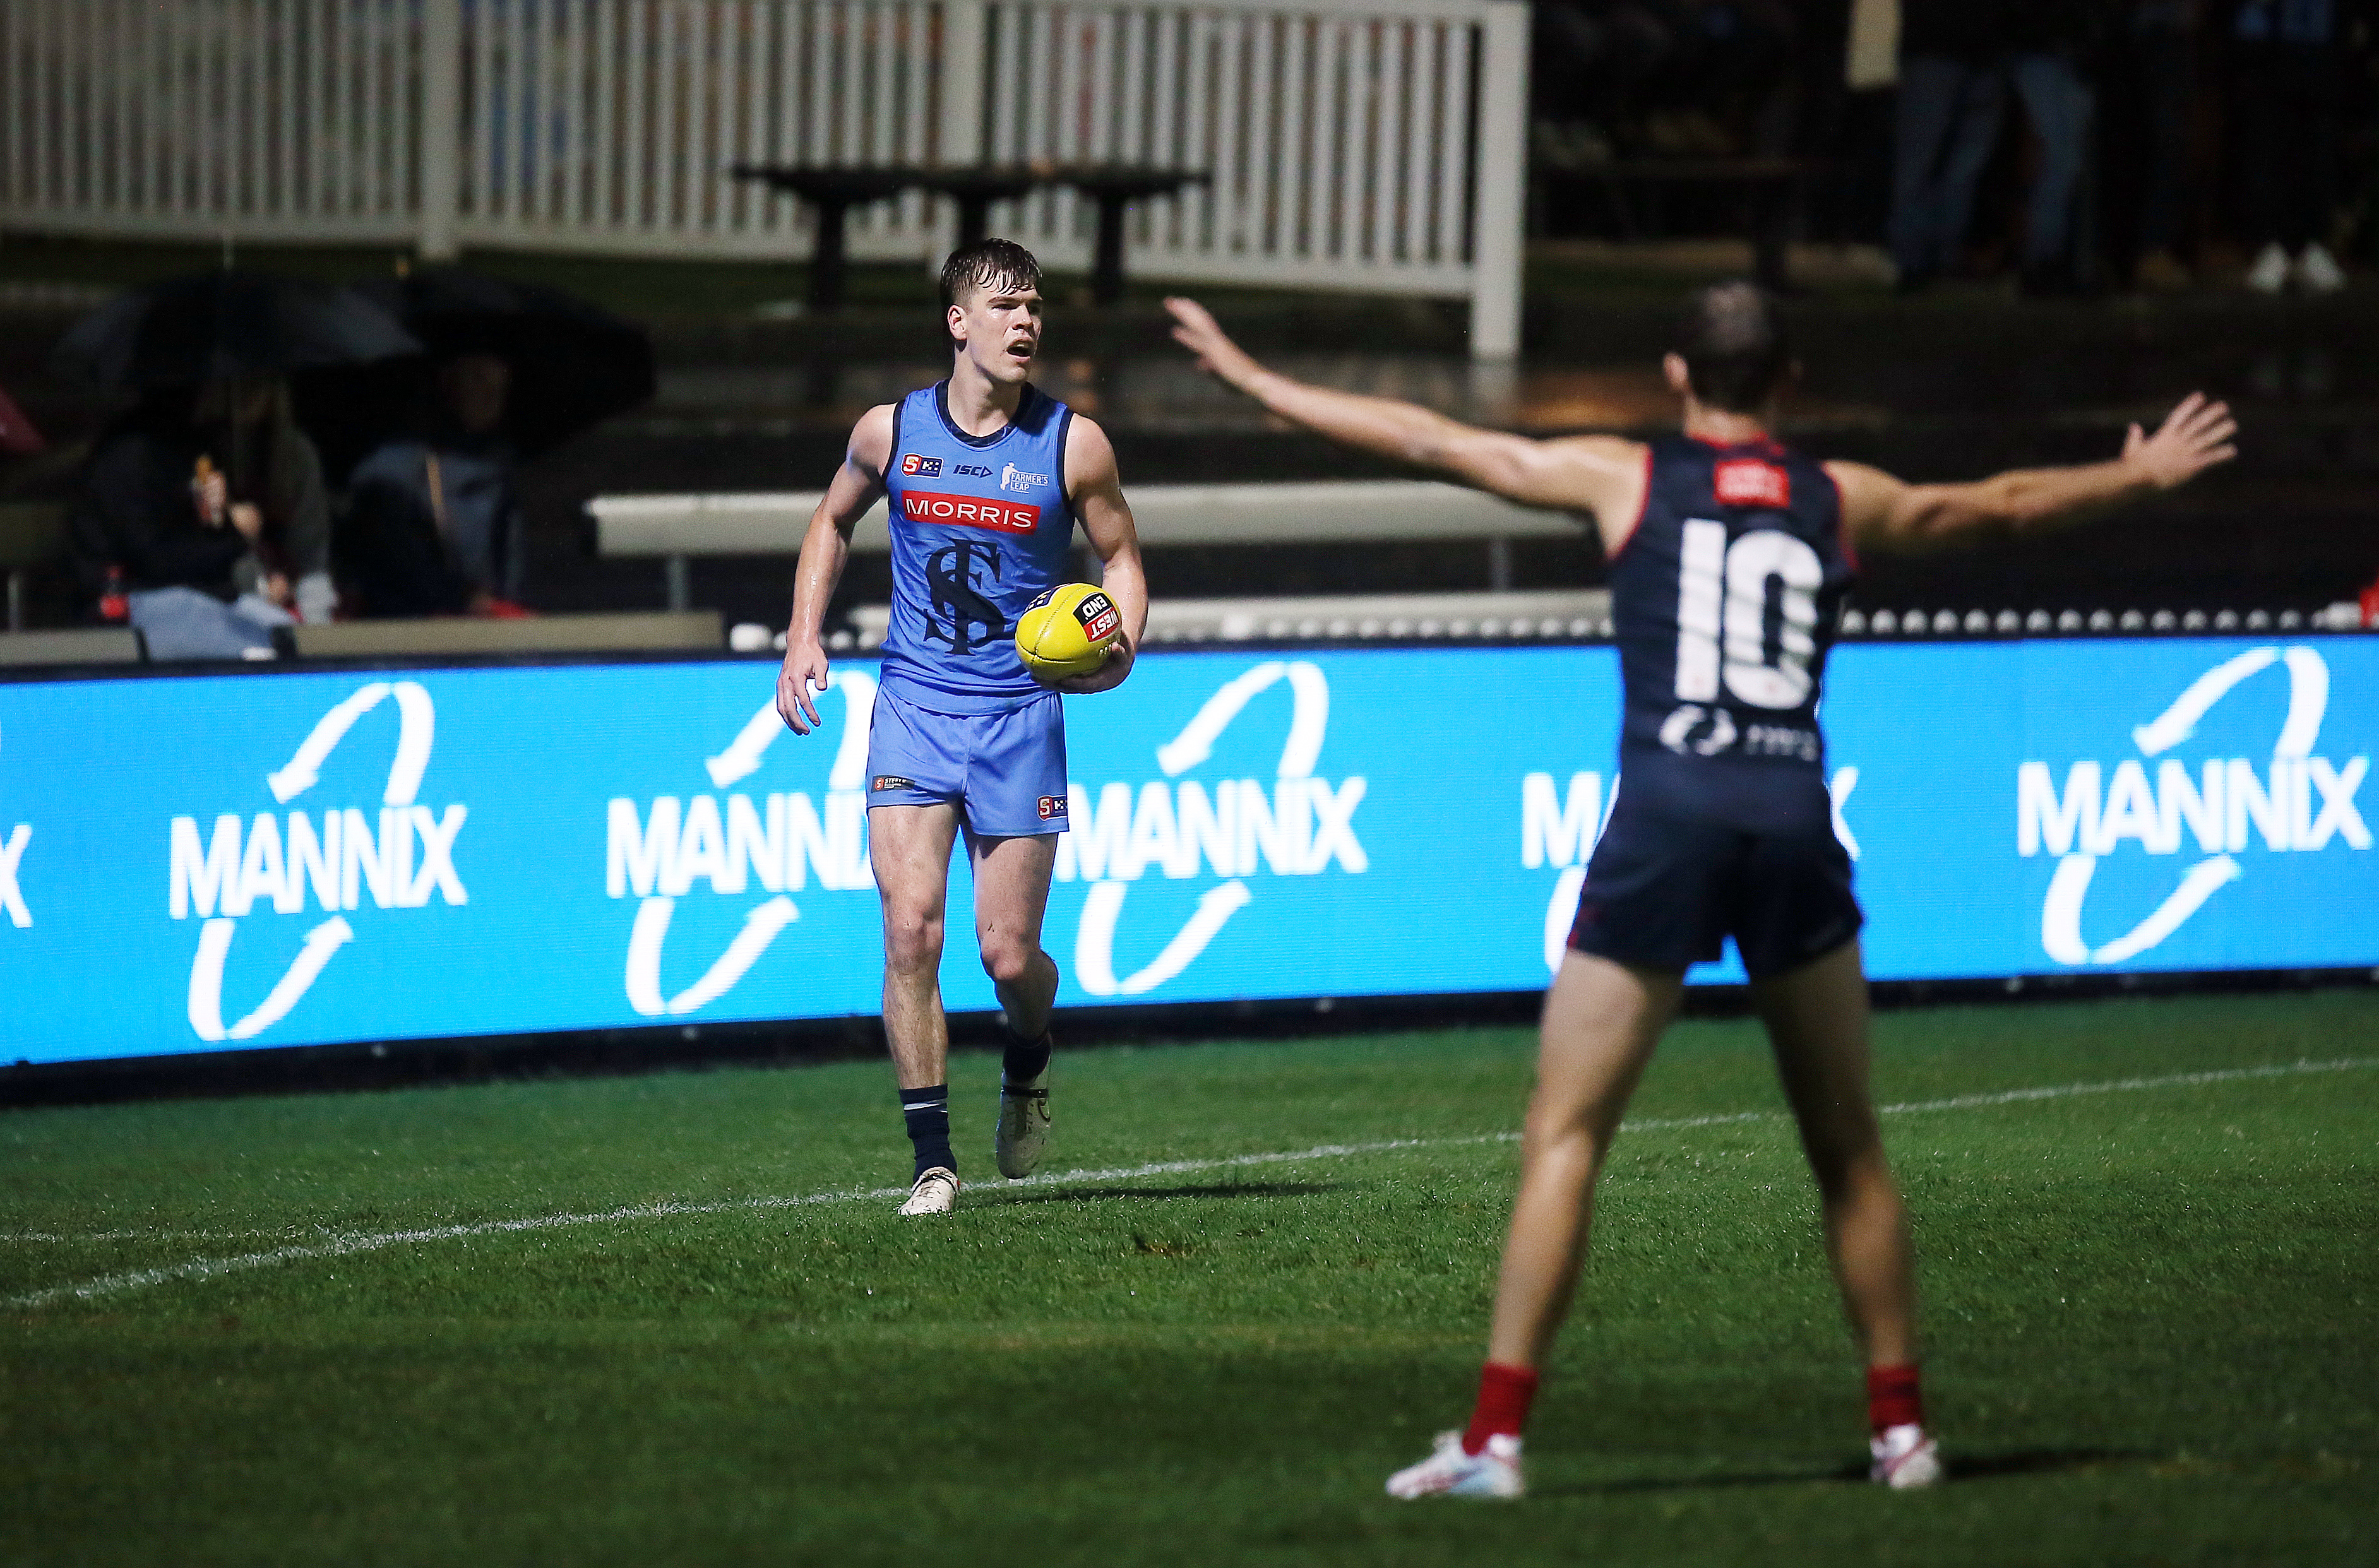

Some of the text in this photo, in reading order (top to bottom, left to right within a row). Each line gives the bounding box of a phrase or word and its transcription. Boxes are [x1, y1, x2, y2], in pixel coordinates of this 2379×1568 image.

[953, 465, 982, 477] ISC
[1011, 473, 1048, 485] FARMER'S
[1010, 482, 1030, 491] LEAP
[905, 499, 1032, 528] MORRIS
[1082, 595, 1108, 617] END
[1674, 518, 1823, 710] 10
[1091, 610, 1119, 639] WEST
[2018, 754, 2375, 858] MANNIX
[1054, 776, 1369, 883] MANNIX
[170, 804, 468, 920] MANNIX
